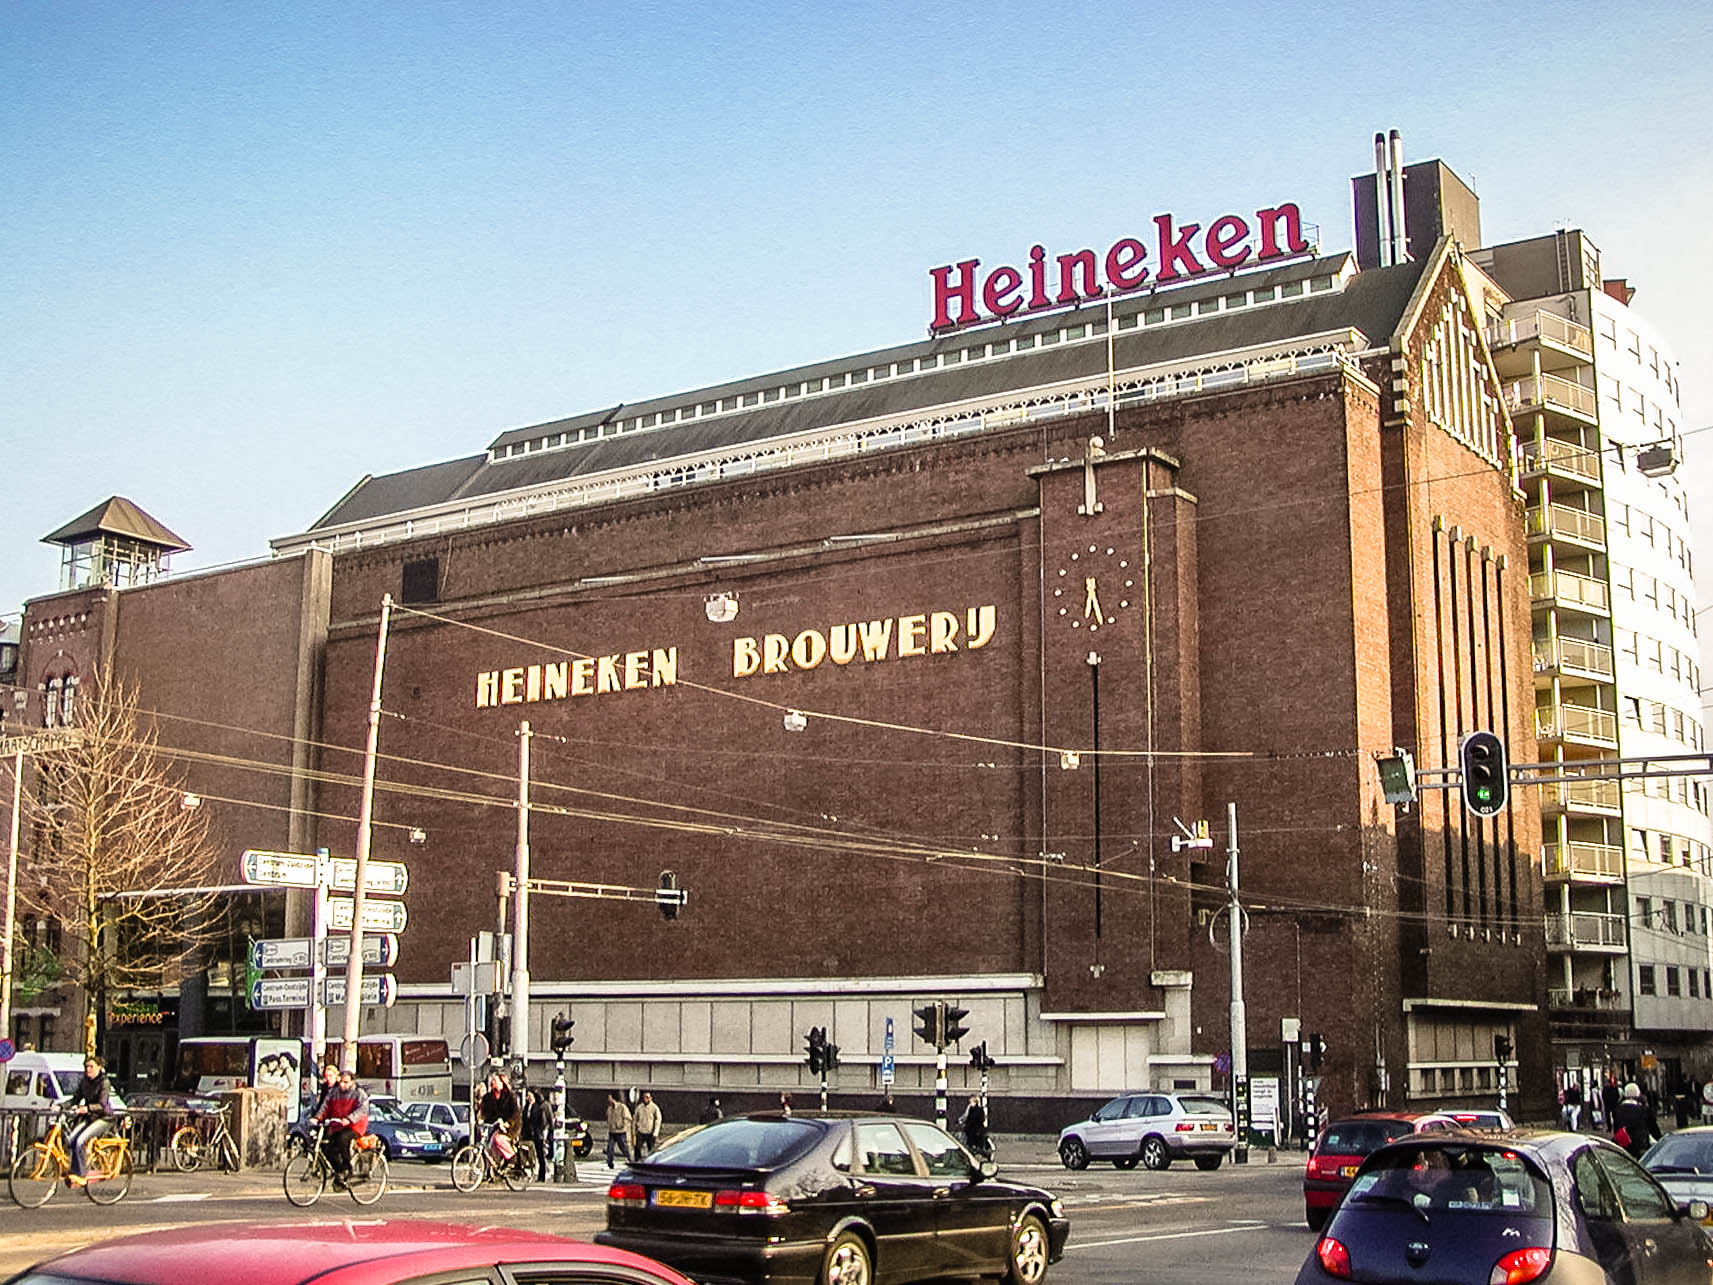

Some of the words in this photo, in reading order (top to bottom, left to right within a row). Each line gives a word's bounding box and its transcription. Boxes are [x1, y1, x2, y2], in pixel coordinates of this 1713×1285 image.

[929, 202, 1309, 329] Heineken
[476, 646, 678, 709] HEINEKEN
[885, 1056, 892, 1068] P
